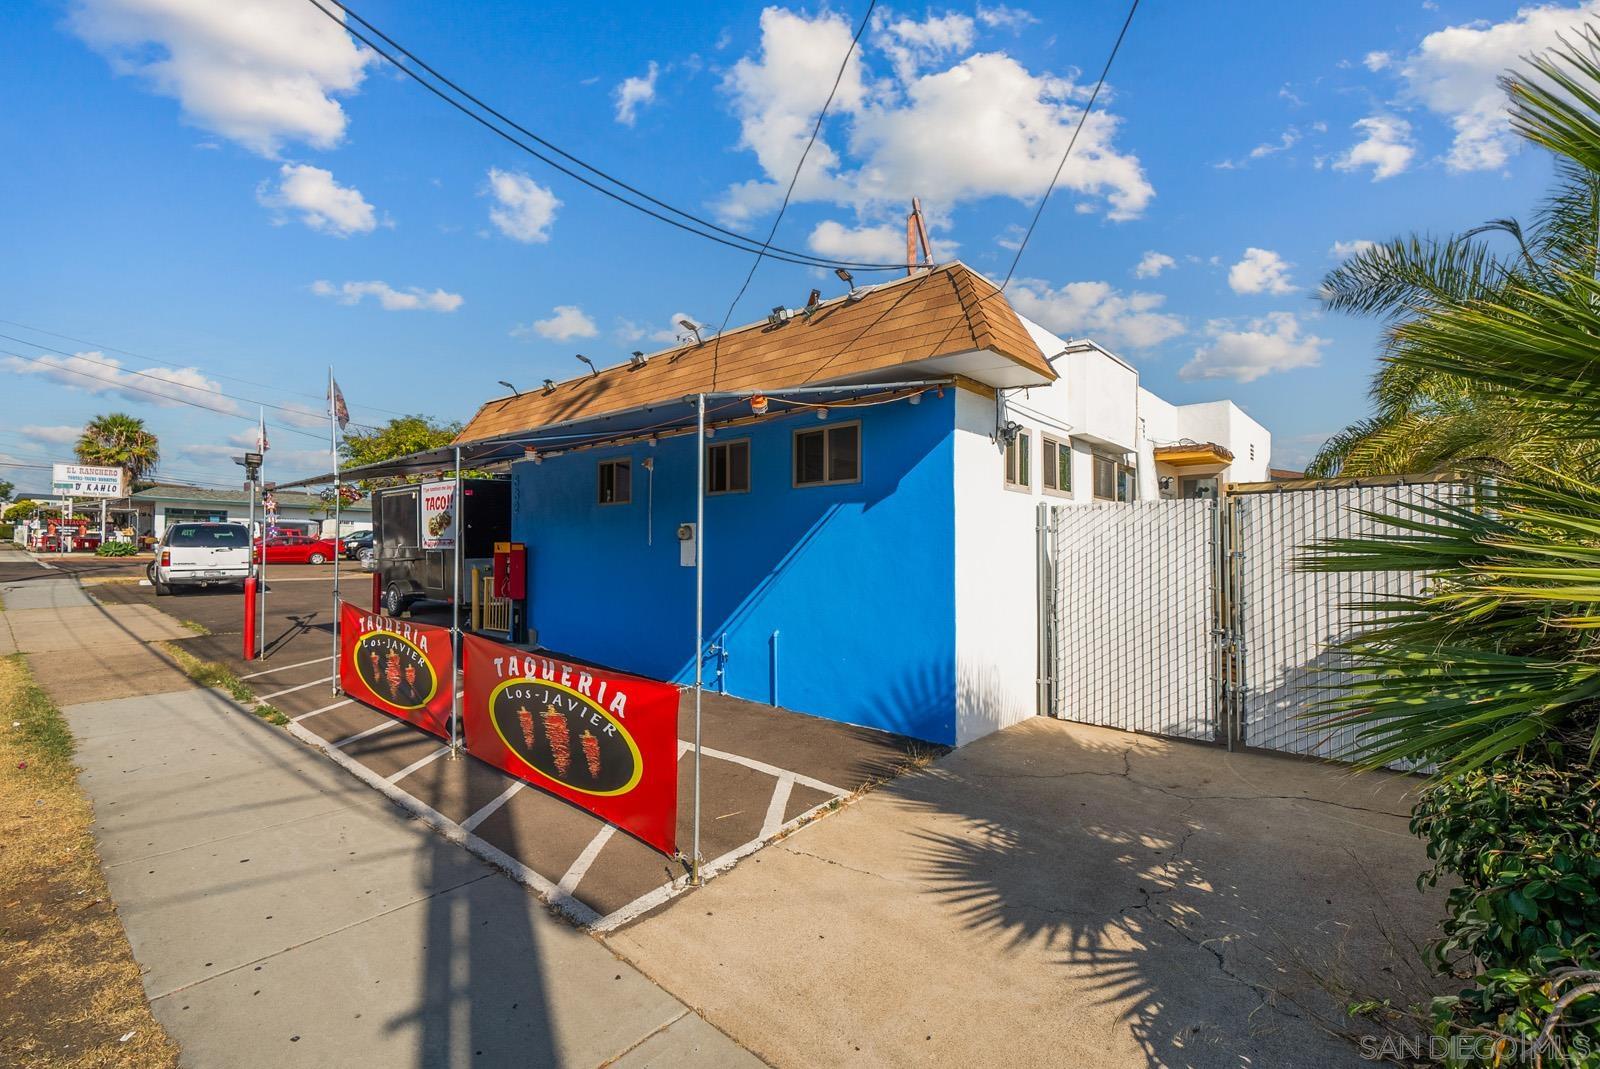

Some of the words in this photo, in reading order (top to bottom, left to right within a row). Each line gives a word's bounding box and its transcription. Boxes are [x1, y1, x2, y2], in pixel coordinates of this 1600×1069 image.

[79, 467, 117, 476] RANCHERO
[87, 483, 117, 492] KAHLO
[425, 494, 453, 511] TACO!!
[359, 616, 429, 653] TAQUERIA
[494, 657, 627, 718] TAQUERIA
